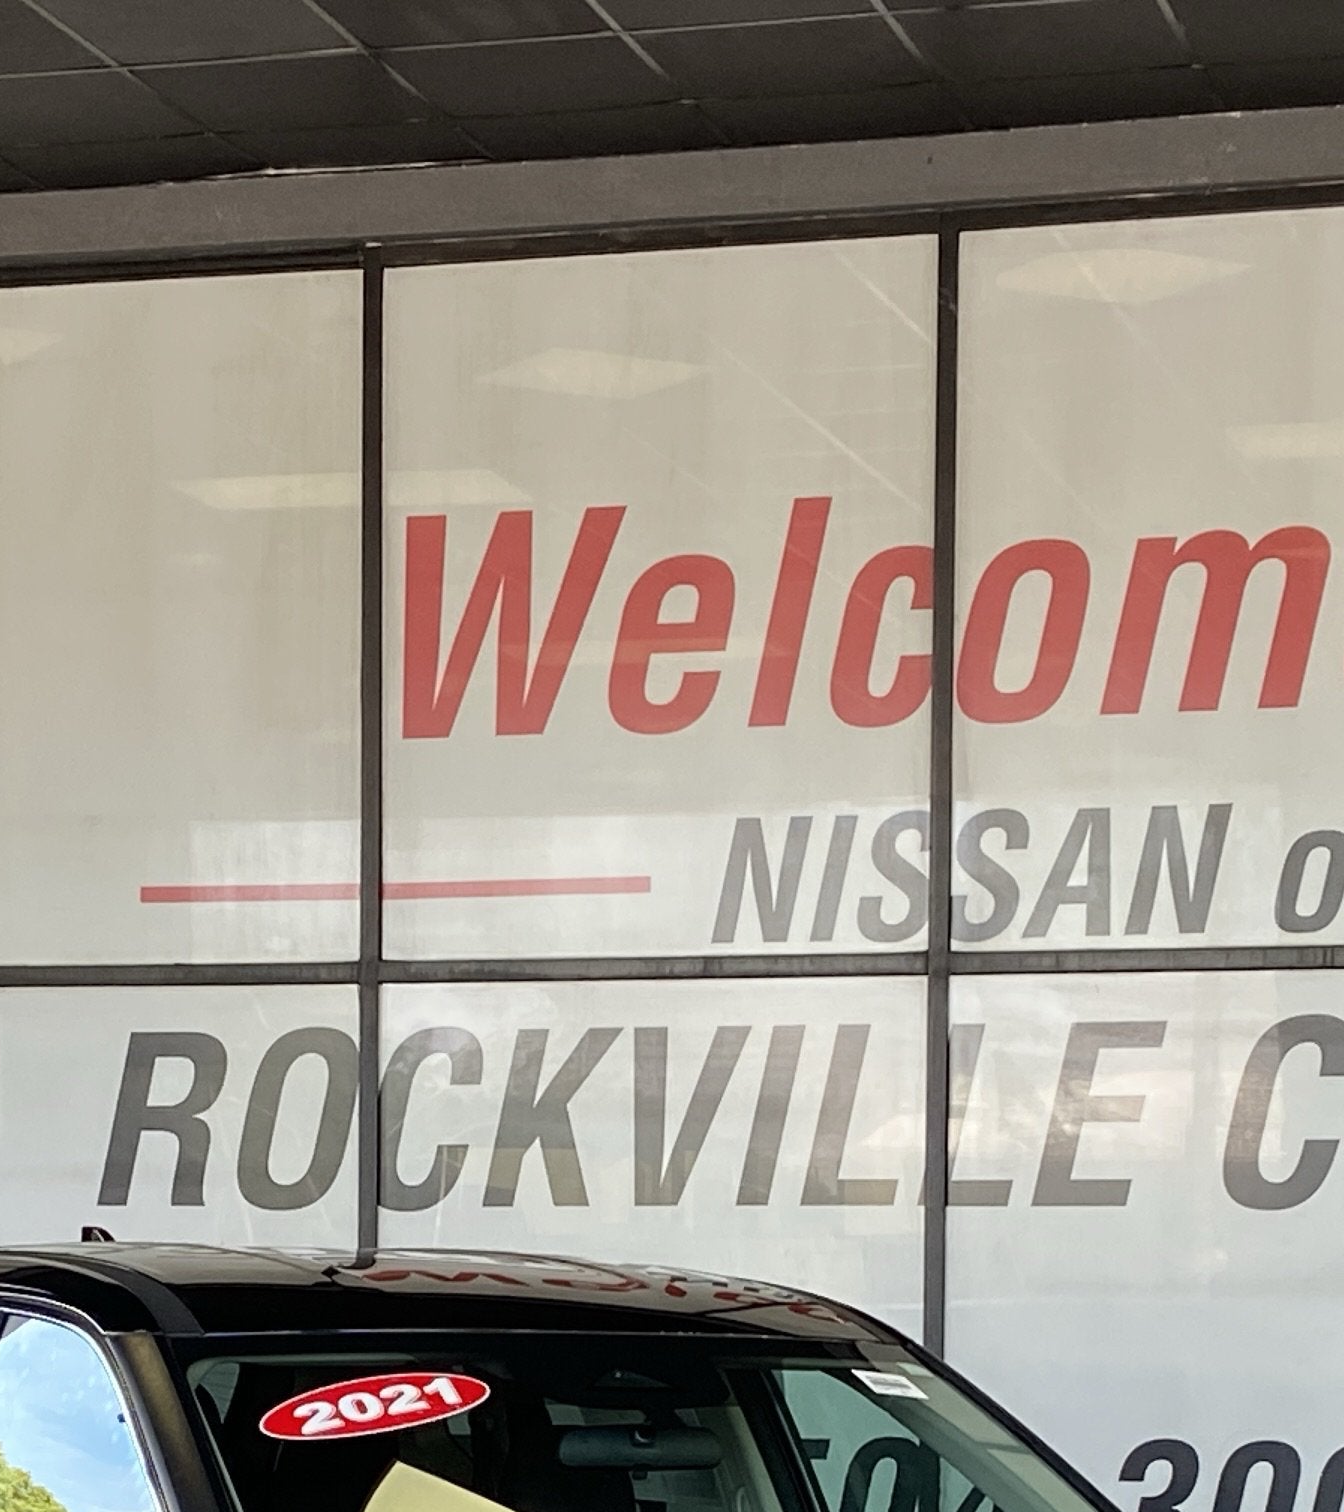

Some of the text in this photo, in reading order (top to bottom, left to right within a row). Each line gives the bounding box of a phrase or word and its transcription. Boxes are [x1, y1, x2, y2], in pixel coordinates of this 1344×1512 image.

[712, 802, 1234, 943] NISSAN
[97, 1018, 1167, 1210] ROCKVILLE
[293, 1376, 463, 1435] 2021
